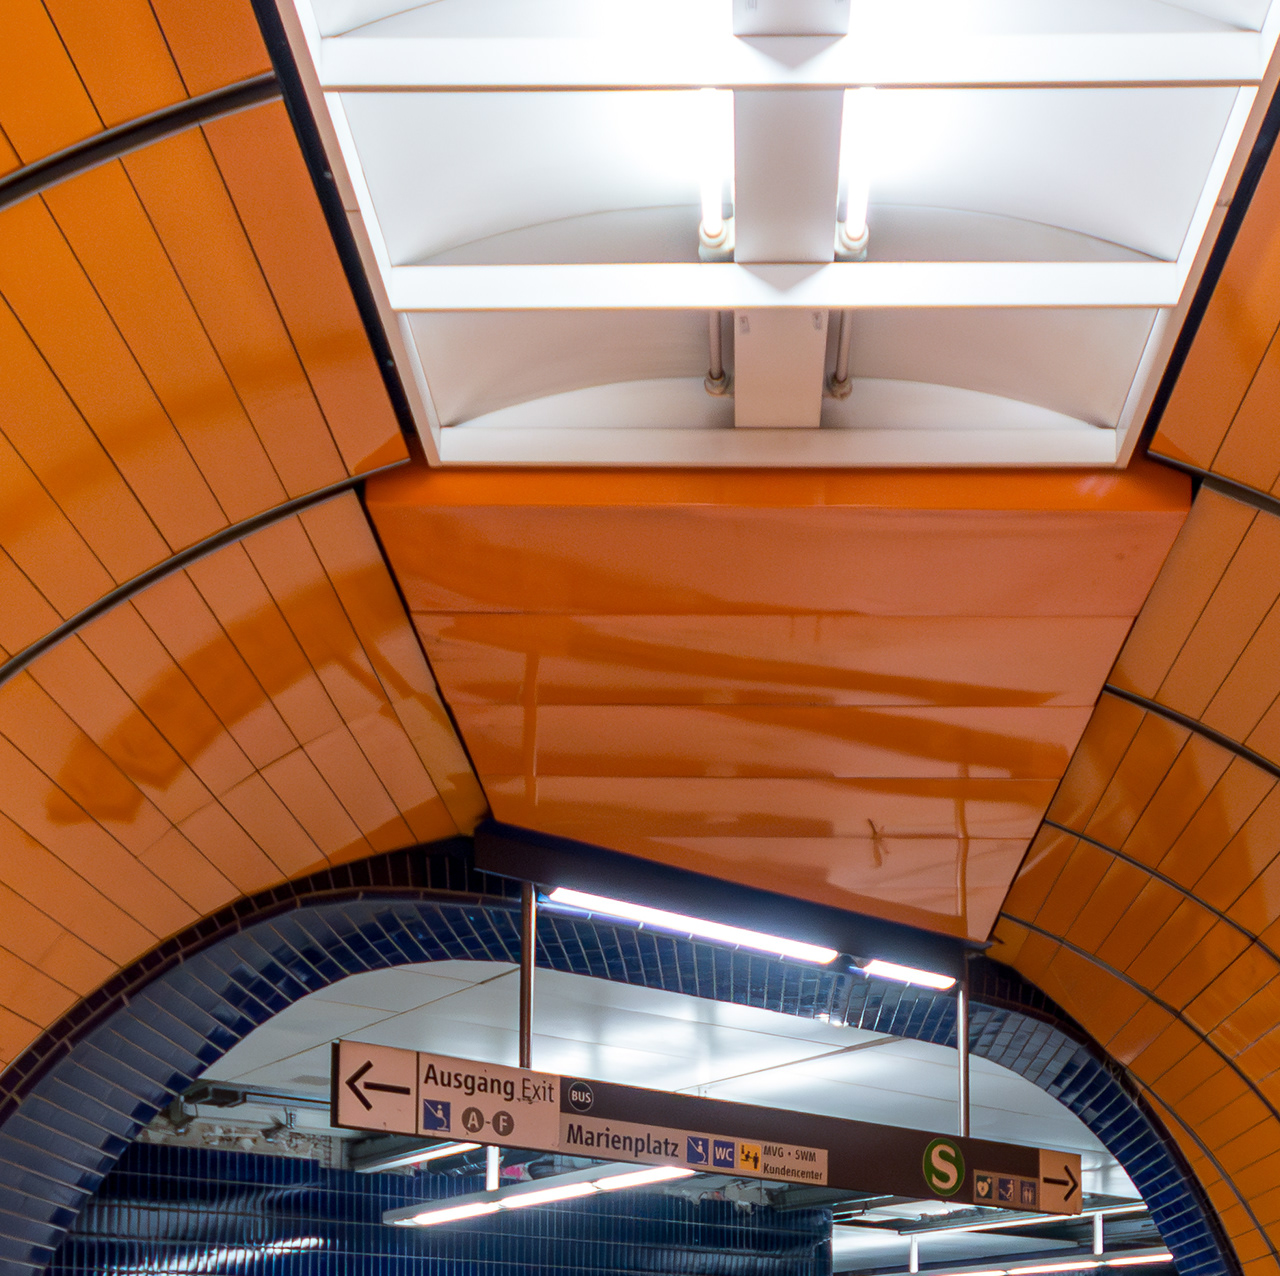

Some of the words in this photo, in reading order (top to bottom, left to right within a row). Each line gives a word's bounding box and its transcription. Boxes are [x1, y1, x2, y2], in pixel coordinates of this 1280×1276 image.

[424, 1064, 515, 1101] Ausgang
[522, 1078, 555, 1103] Exit
[571, 1090, 592, 1104] BUS
[567, 1123, 679, 1158] Marienplatz
[715, 1146, 733, 1161] WC
[763, 1145, 784, 1158] MVG
[795, 1149, 816, 1162] SWM
[763, 1163, 823, 1181] Kundencenter
[931, 1144, 958, 1190] S
